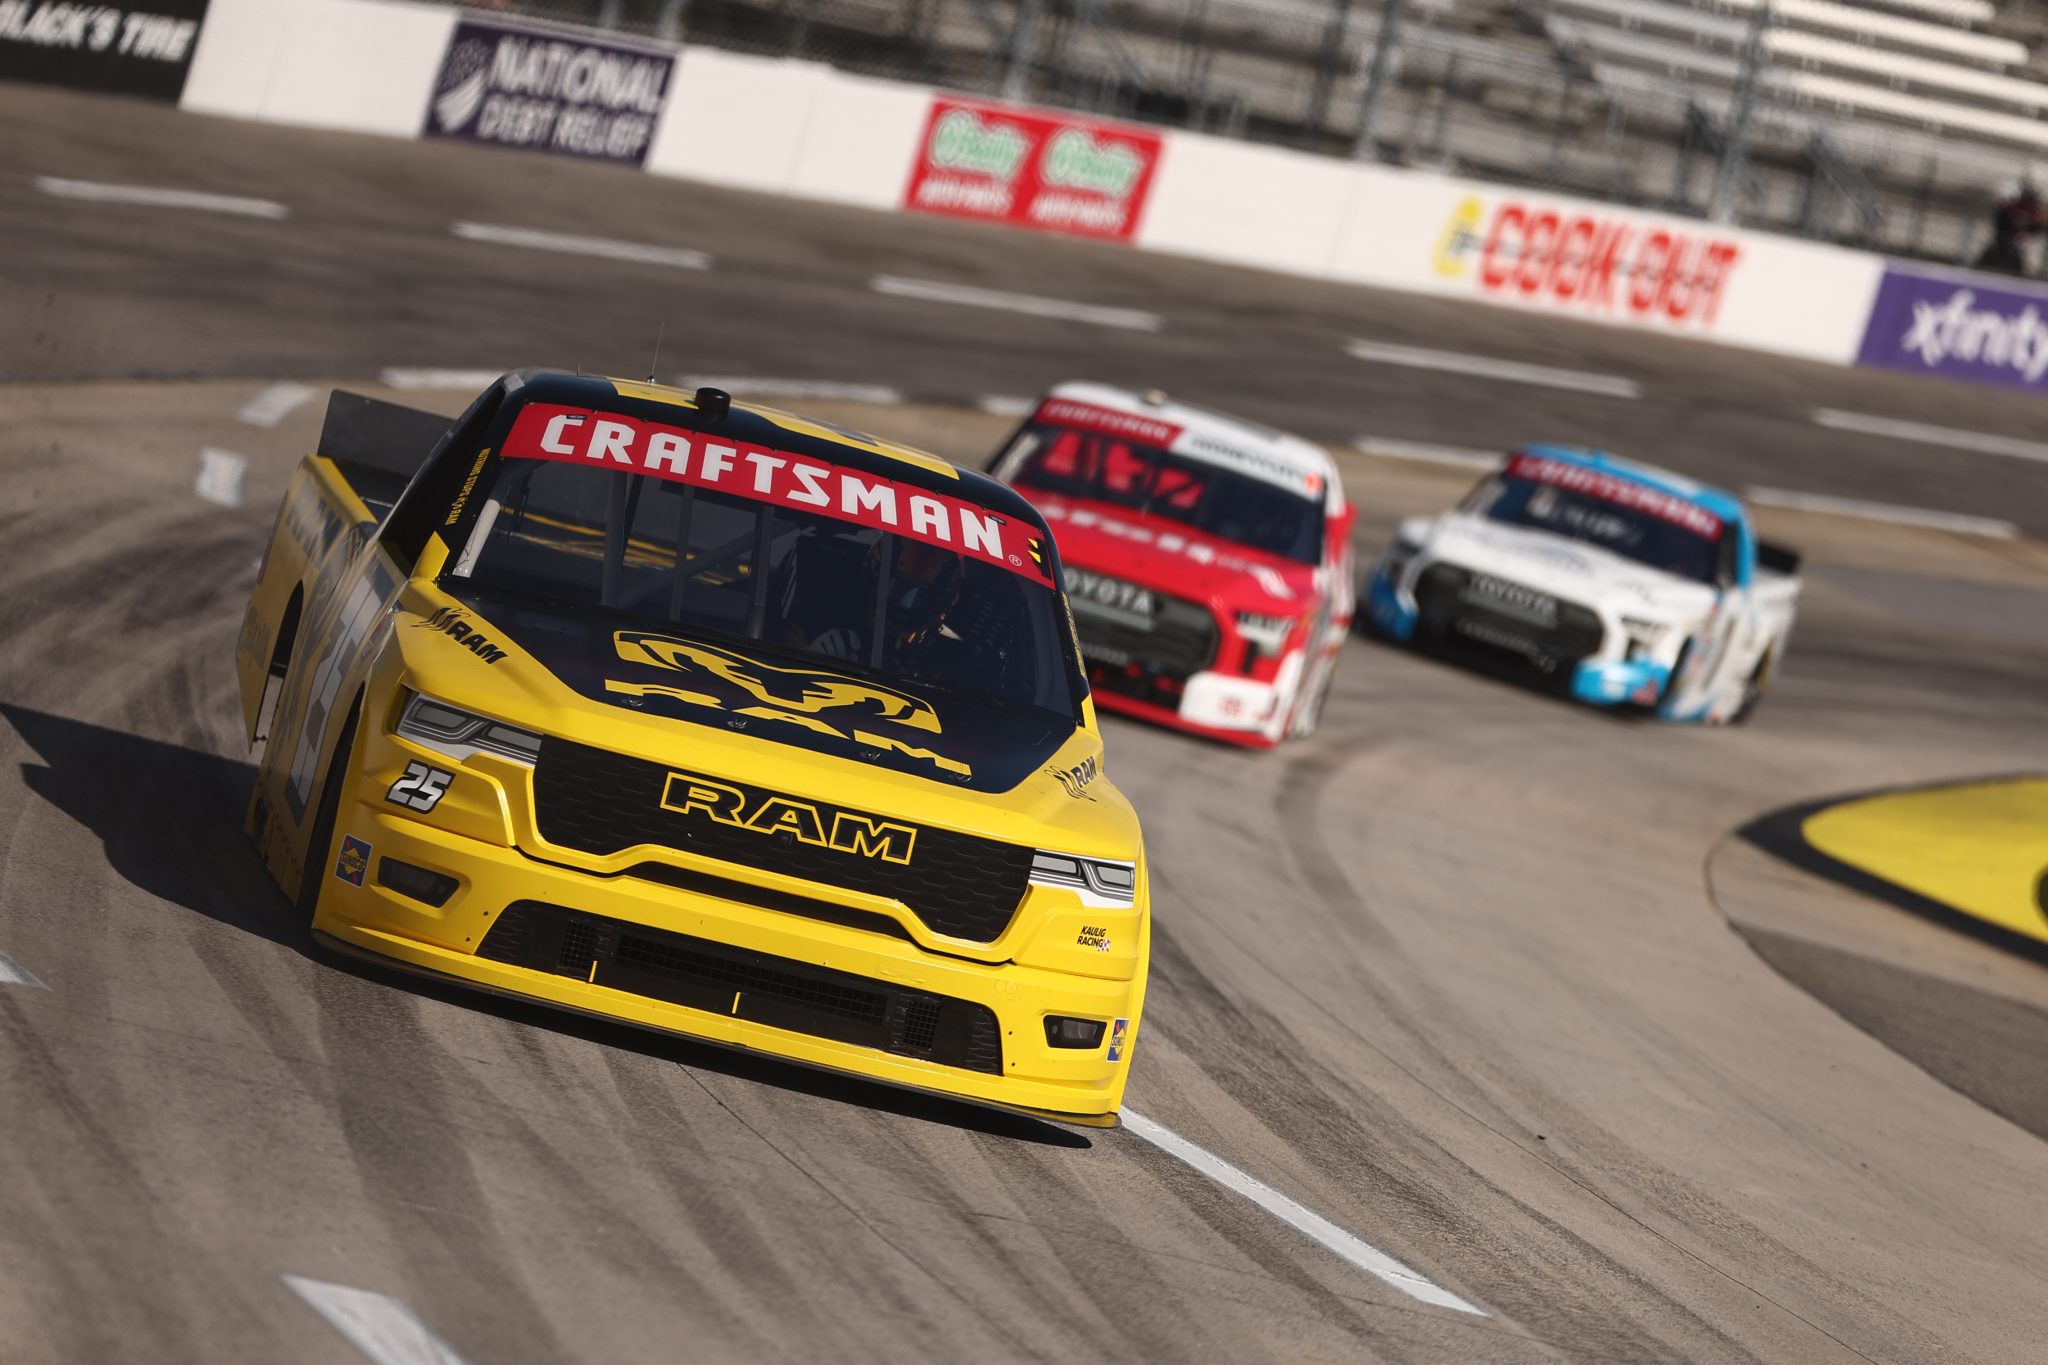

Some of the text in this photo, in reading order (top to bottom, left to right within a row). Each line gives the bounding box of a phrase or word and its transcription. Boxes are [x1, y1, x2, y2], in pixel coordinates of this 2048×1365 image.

[118, 11, 198, 62] TIRE
[489, 35, 668, 114] NATIONAL
[476, 93, 652, 158] DEBT RELIEF
[1480, 204, 1738, 327] COOK OUT
[1902, 289, 2048, 383] xfinity
[539, 413, 1004, 560] CRAFTSMAN
[445, 620, 508, 665] RAM
[384, 758, 456, 814] 25
[660, 771, 918, 866] RAM
[1077, 936, 1104, 948] RACING
[1081, 925, 1107, 938] KAULIG
